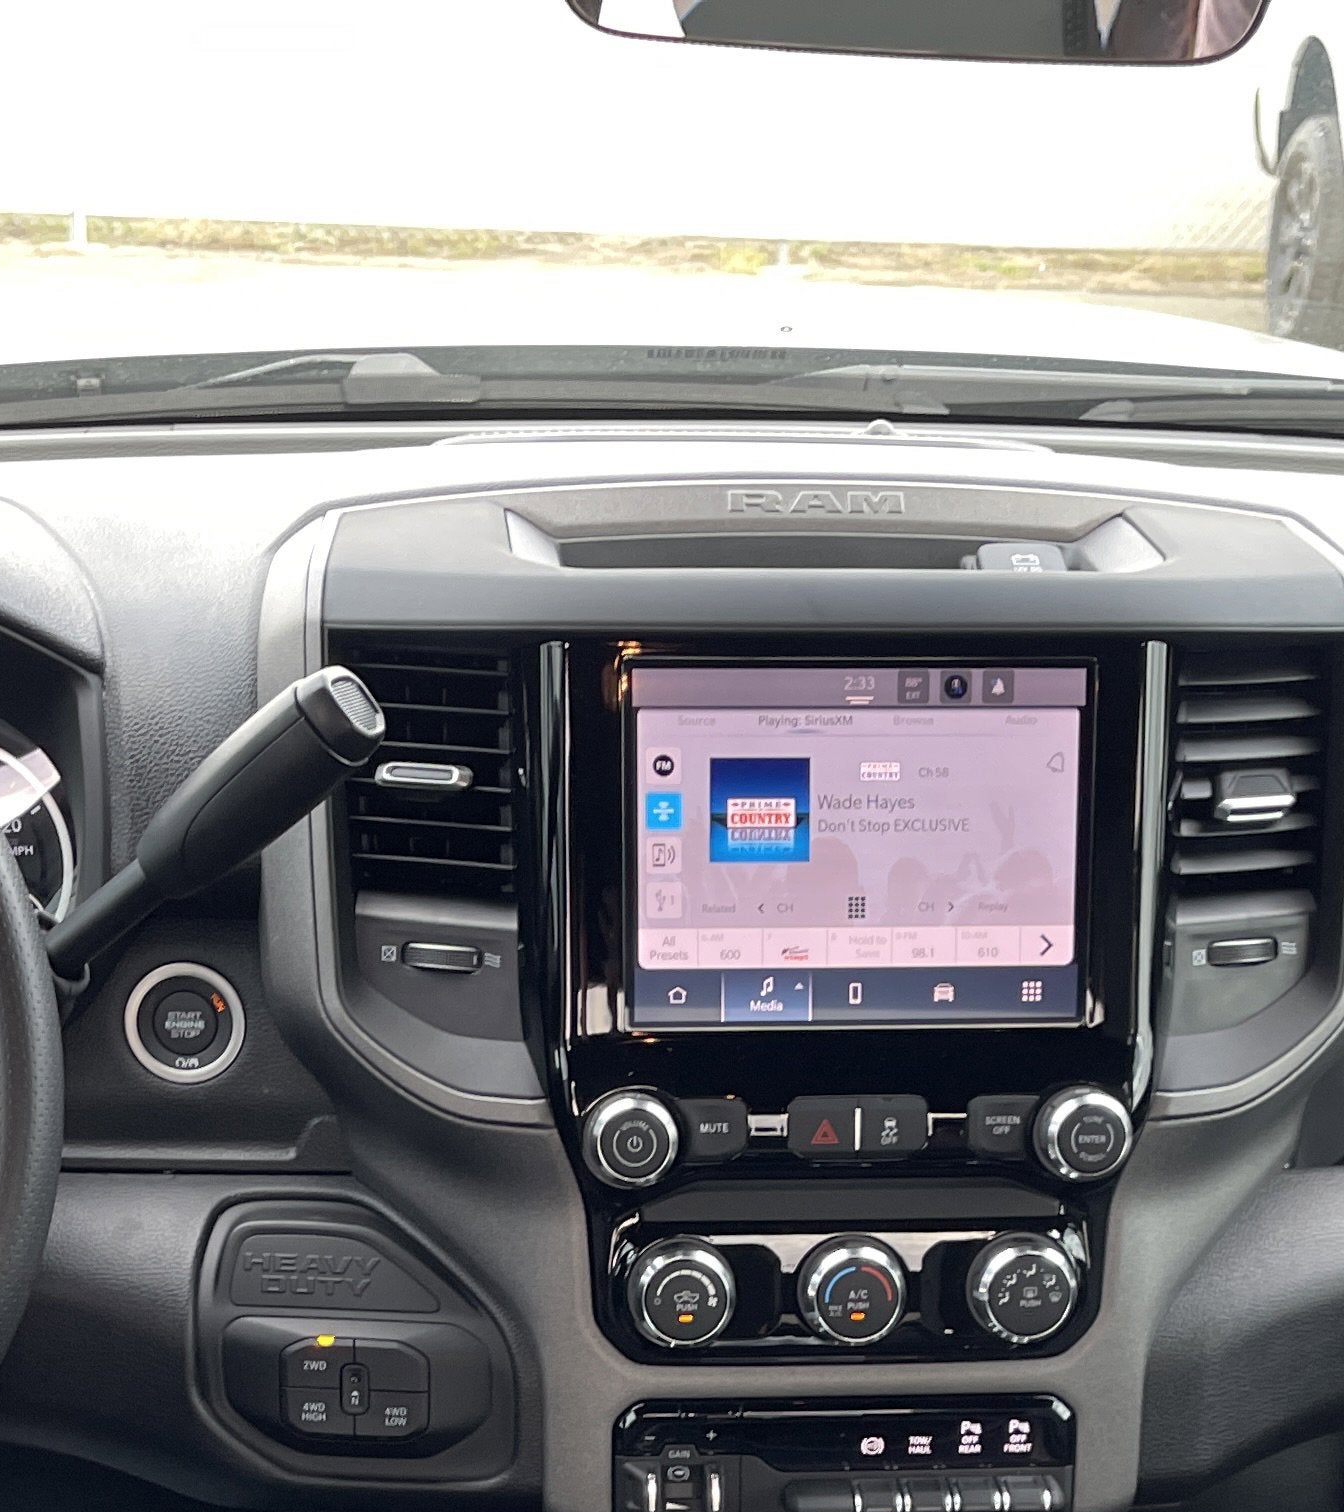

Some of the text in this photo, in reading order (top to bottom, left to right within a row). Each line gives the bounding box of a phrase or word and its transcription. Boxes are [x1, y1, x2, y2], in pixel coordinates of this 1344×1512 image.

[726, 489, 906, 515] RAM
[844, 676, 875, 690] 2:33
[678, 715, 716, 726] Source
[758, 714, 853, 728] Playing: SiriusXM
[893, 715, 934, 725] Browse
[1005, 715, 1038, 725] Audio
[656, 761, 672, 771] FM
[918, 766, 934, 778] Ch
[817, 794, 915, 813] Wade Hayes
[730, 813, 792, 824] COUNTRY
[817, 818, 970, 835] Don't Stop EXCLUSIVE
[701, 903, 736, 913] Related
[777, 903, 794, 913] CH
[918, 902, 935, 912] CH
[978, 902, 1008, 913] Replay
[662, 936, 676, 946] All
[649, 951, 689, 961] Presets
[977, 948, 999, 958] 610
[749, 1000, 784, 1012] Media
[167, 1011, 202, 1020] START
[170, 1030, 201, 1038] STOP
[984, 1115, 1021, 1125] SCREEN
[699, 1122, 729, 1133] MUTE
[992, 1126, 1011, 1135] OFF
[880, 1136, 898, 1145] OFF
[1078, 1134, 1106, 1144] ENTER
[243, 1251, 381, 1276] HEAVY
[261, 1275, 372, 1297] DUTY
[848, 1289, 869, 1300] A/C
[676, 1303, 698, 1312] PUSH
[303, 1360, 327, 1371] 2WD
[302, 1402, 326, 1412] 4WD
[384, 1406, 407, 1416] 4WD
[301, 1412, 327, 1422] HIGH
[385, 1416, 408, 1427] LOW
[961, 1435, 979, 1444] OFF
[1009, 1434, 1027, 1443] OFF
[908, 1445, 932, 1454] HAUL
[1003, 1443, 1032, 1453] FRONT
[668, 1450, 691, 1459] GAIN
